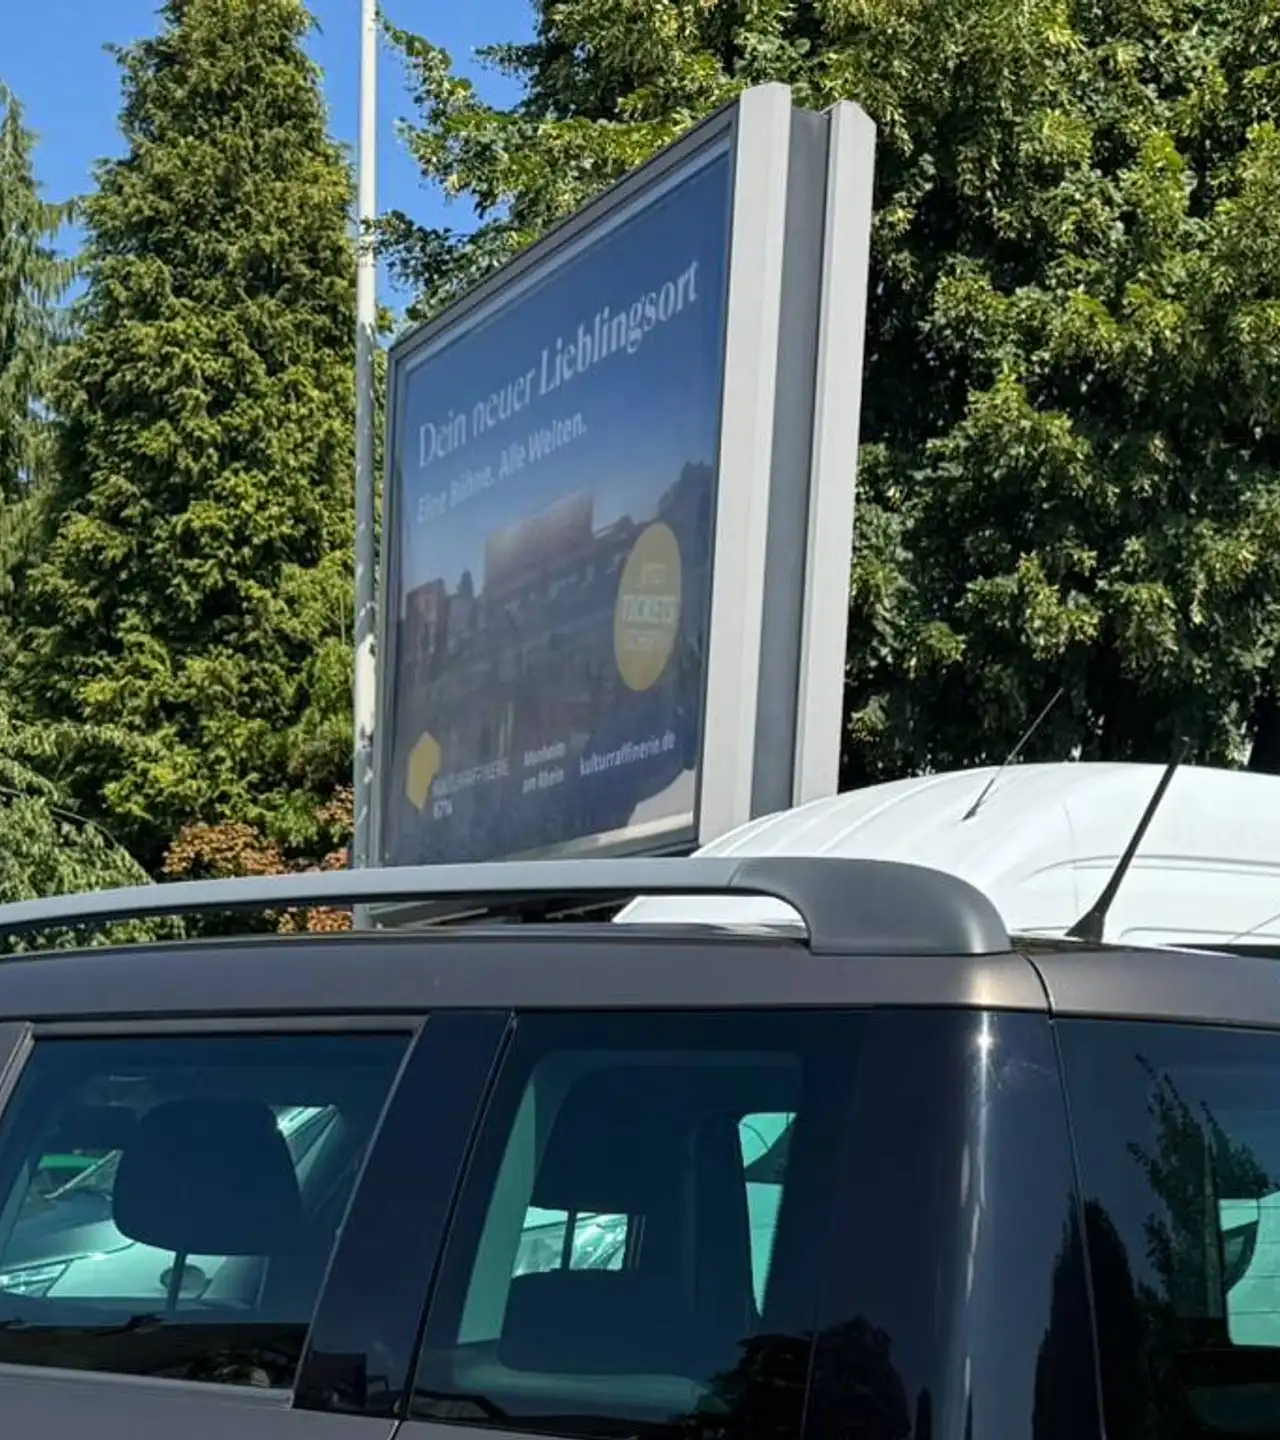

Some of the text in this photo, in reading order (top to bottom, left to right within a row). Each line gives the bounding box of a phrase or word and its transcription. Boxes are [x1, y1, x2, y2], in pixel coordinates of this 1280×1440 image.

[419, 260, 699, 468] Dein neuer Lieblingsort
